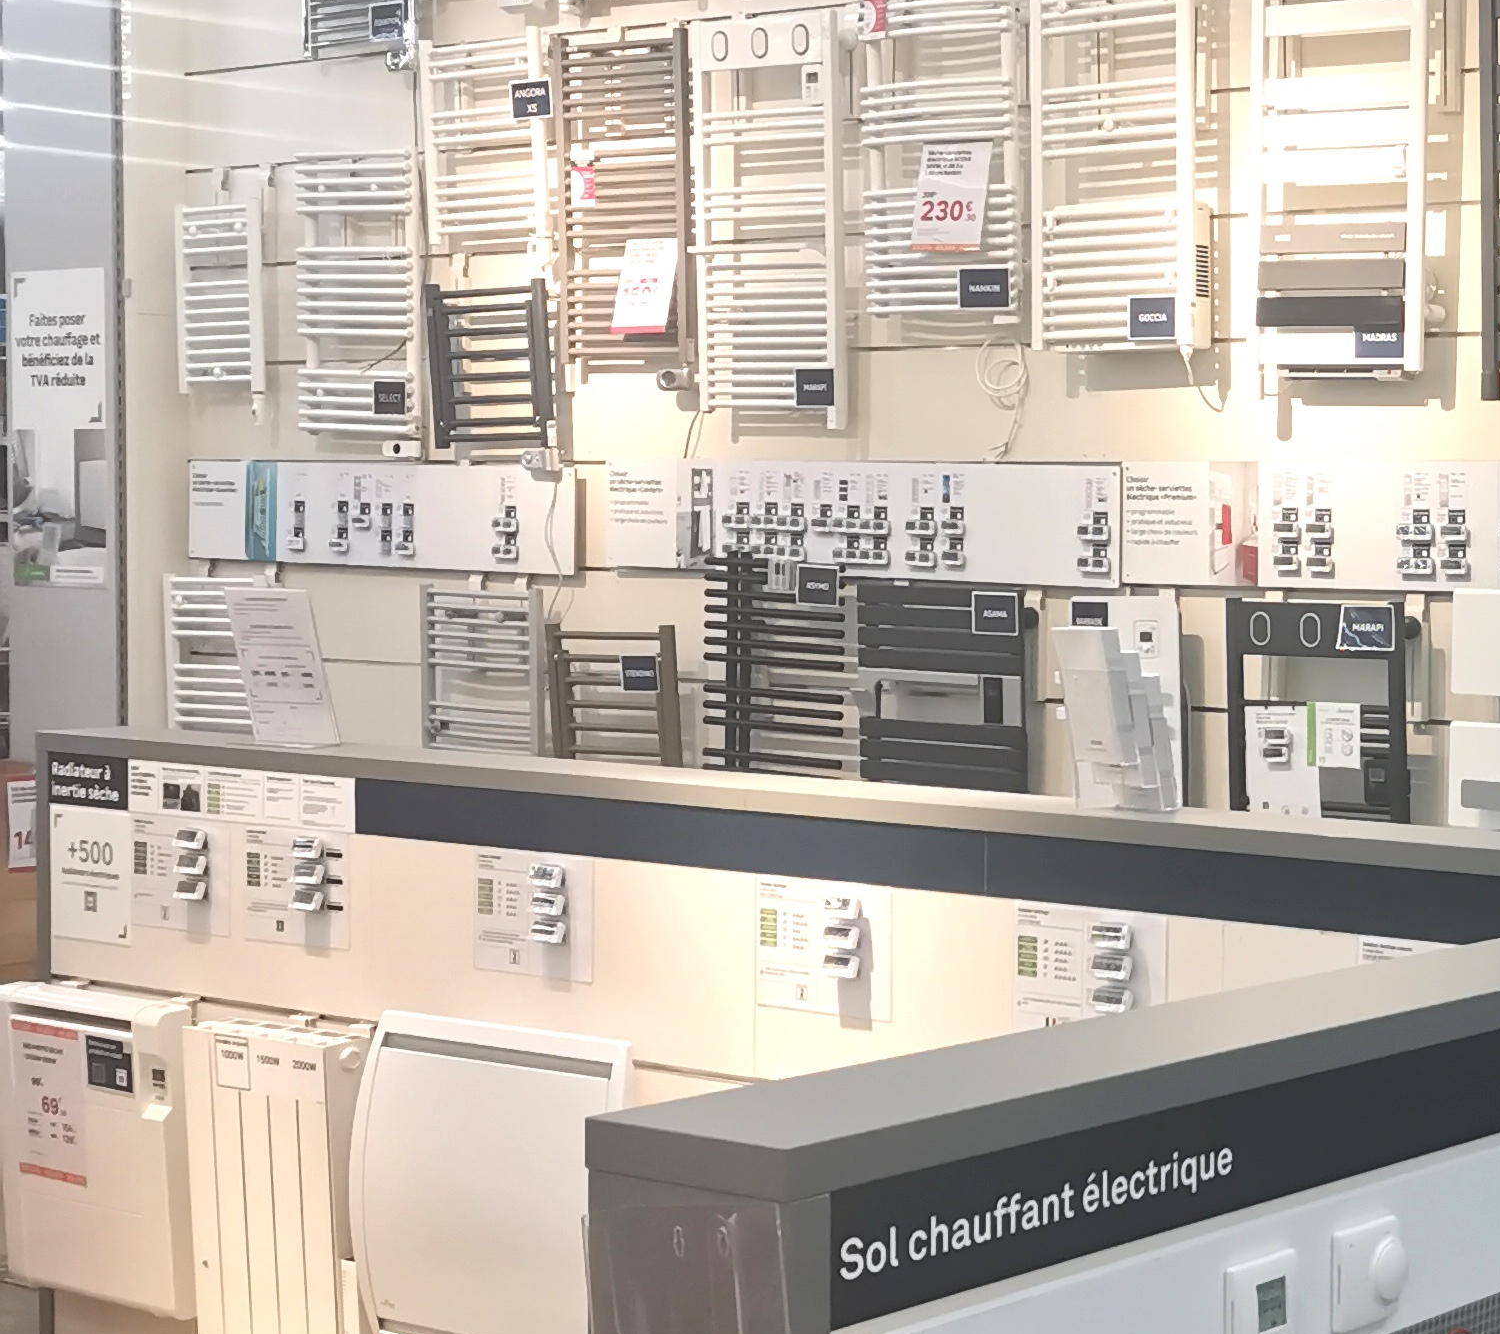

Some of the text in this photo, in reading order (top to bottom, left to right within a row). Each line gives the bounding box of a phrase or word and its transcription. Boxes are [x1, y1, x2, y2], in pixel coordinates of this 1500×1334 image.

[513, 87, 547, 99] ANGORA
[920, 200, 964, 222] 230
[1361, 332, 1398, 343] MADRAS
[30, 372, 87, 387] TVA réduite
[67, 839, 114, 866] +500
[256, 1054, 280, 1066] 1500W
[292, 1059, 317, 1072] 2000W
[41, 1095, 59, 1115] 69
[839, 1145, 1234, 1281] Sol chauffant électrique
